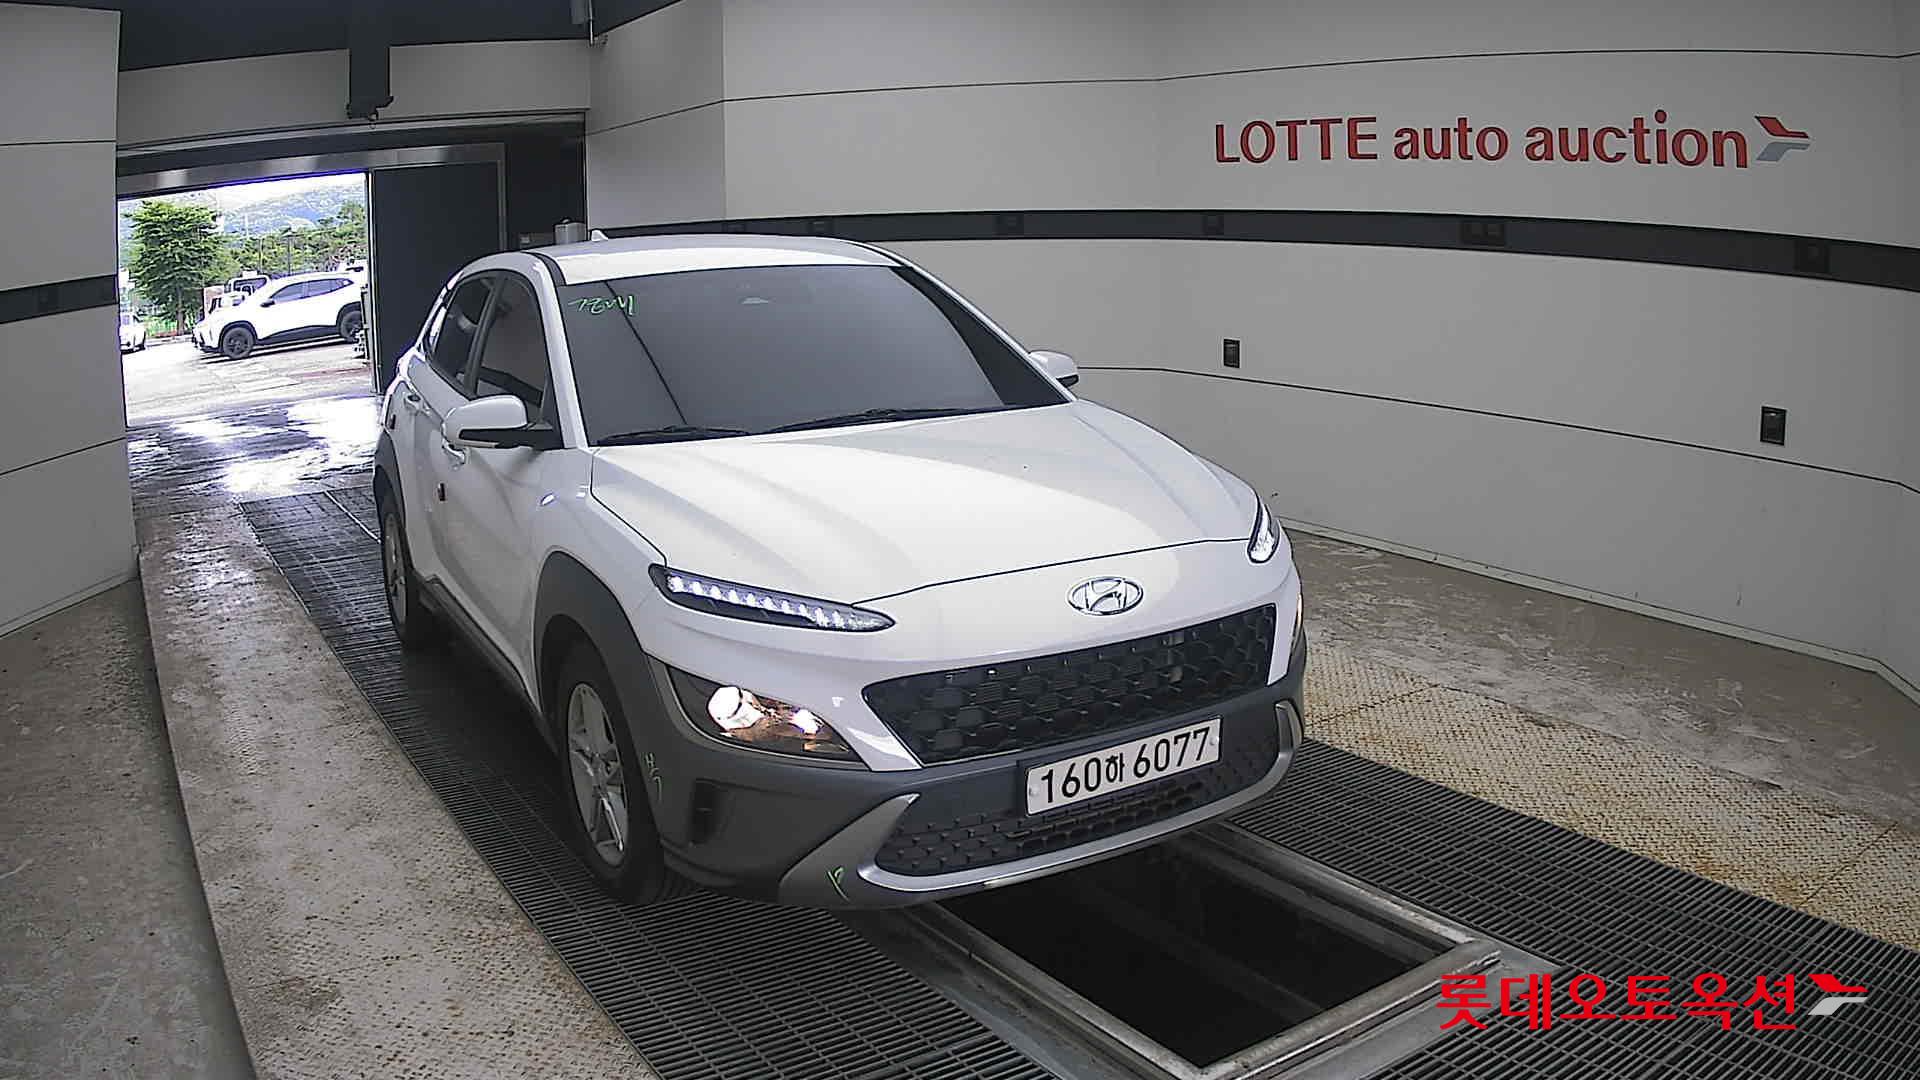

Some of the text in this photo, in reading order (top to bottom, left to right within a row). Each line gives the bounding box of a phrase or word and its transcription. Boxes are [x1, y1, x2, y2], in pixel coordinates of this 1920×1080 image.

[1214, 109, 1749, 169] LOTTE auto auction
[1041, 726, 1211, 804] 160하 6077
